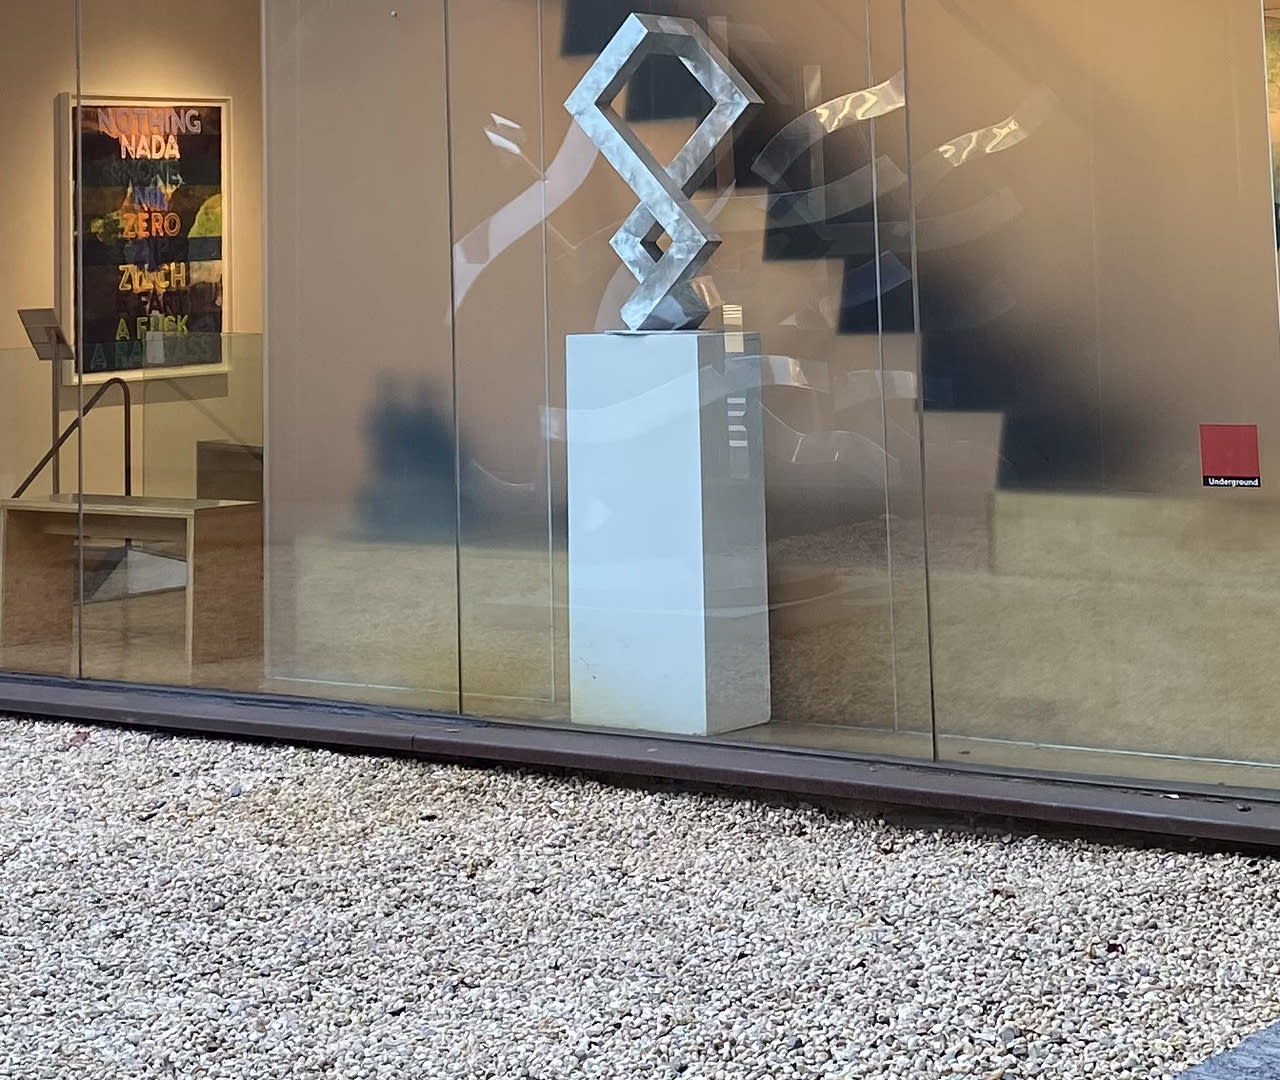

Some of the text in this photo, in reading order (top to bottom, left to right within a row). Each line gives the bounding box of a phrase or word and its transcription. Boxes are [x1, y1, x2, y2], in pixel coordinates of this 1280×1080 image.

[97, 108, 202, 135] NOTHING
[120, 134, 181, 160] NADA
[122, 212, 181, 238] ZERO
[116, 318, 130, 341] A
[1208, 477, 1259, 488] Underground
